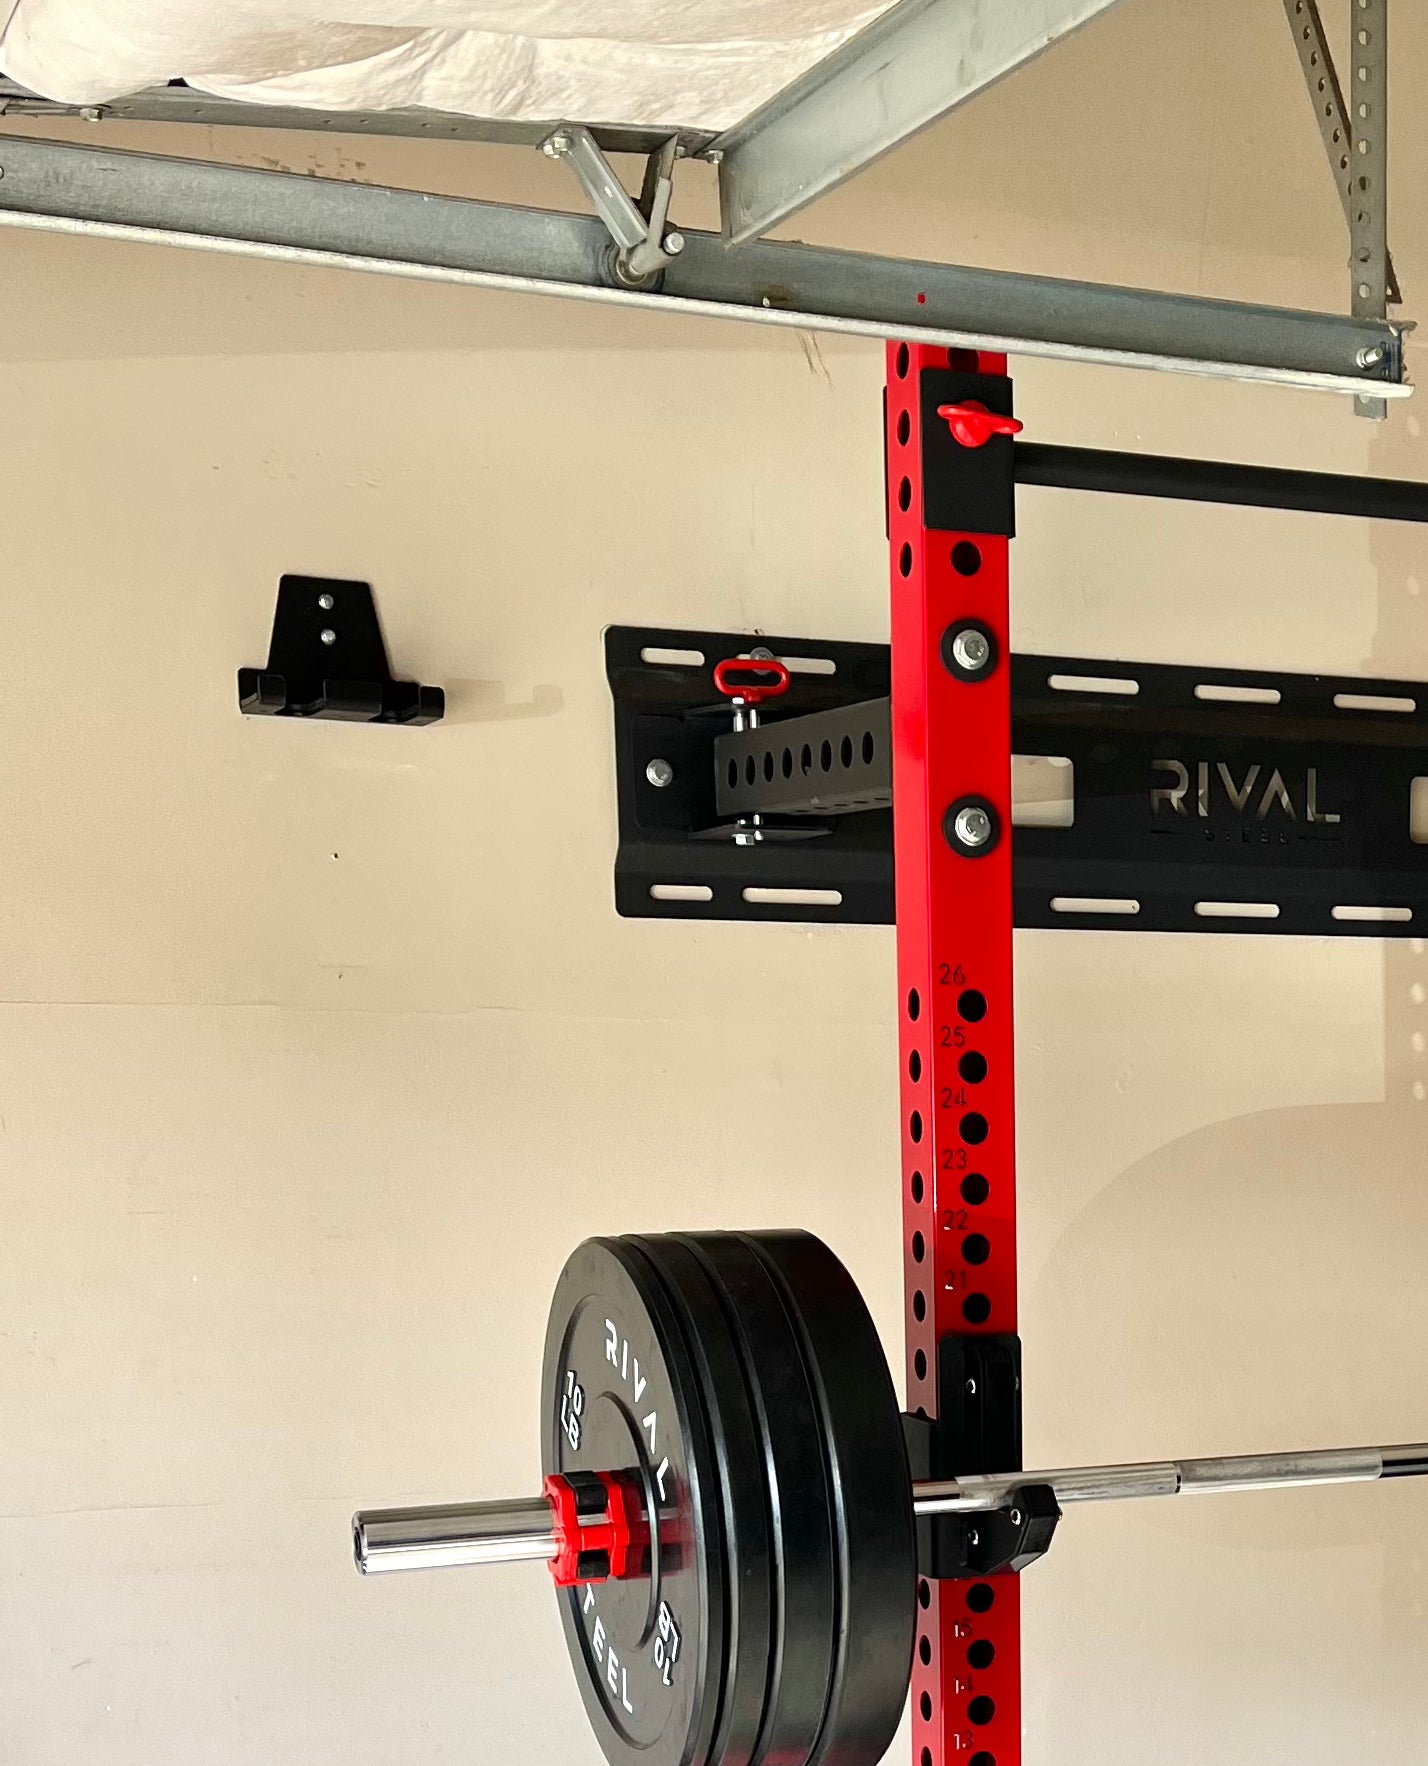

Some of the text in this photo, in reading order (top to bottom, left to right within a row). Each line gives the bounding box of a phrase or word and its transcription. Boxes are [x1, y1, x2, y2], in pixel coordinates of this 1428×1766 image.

[1150, 758, 1341, 824] RIVAL
[939, 963, 966, 985] 26
[940, 1026, 966, 1048] 25
[941, 1088, 967, 1109] 24
[942, 1150, 968, 1170] 23
[943, 1210, 969, 1231] 22
[944, 1271, 967, 1290] 21
[567, 1370, 583, 1416] 10
[605, 1318, 669, 1501] RIVAL
[561, 1394, 579, 1451] LB
[583, 1582, 633, 1714] TEEL
[658, 1601, 679, 1662] LB
[654, 1636, 671, 1686] 10
[953, 1729, 974, 1750] 13
